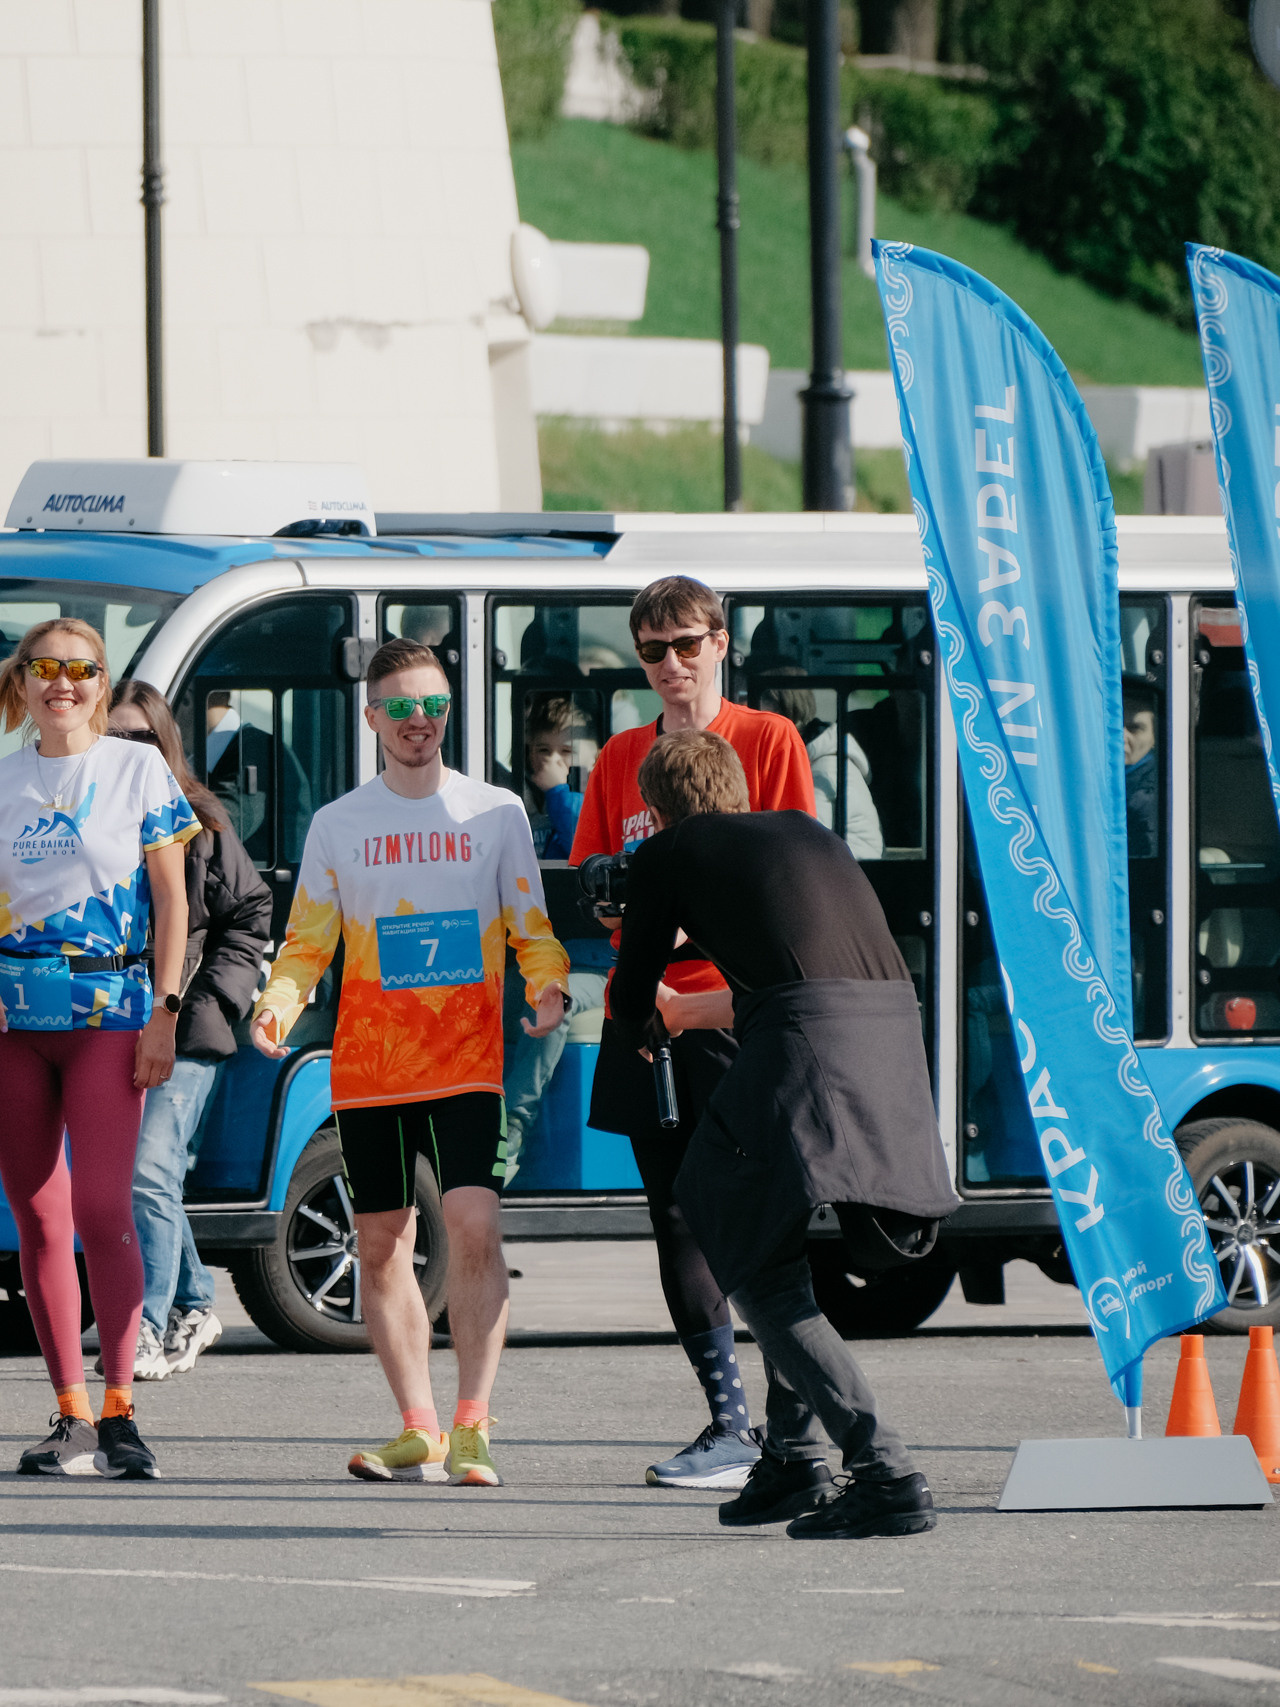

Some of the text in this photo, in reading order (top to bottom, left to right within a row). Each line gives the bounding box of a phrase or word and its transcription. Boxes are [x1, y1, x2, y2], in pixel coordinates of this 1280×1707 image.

[42, 494, 126, 513] AUTOCLIMA
[12, 849, 76, 857] MARATHON
[13, 839, 76, 850] PURE BAIKAL
[364, 831, 472, 867] IZMYLONG
[420, 938, 439, 967] 7
[14, 983, 30, 1010] 1
